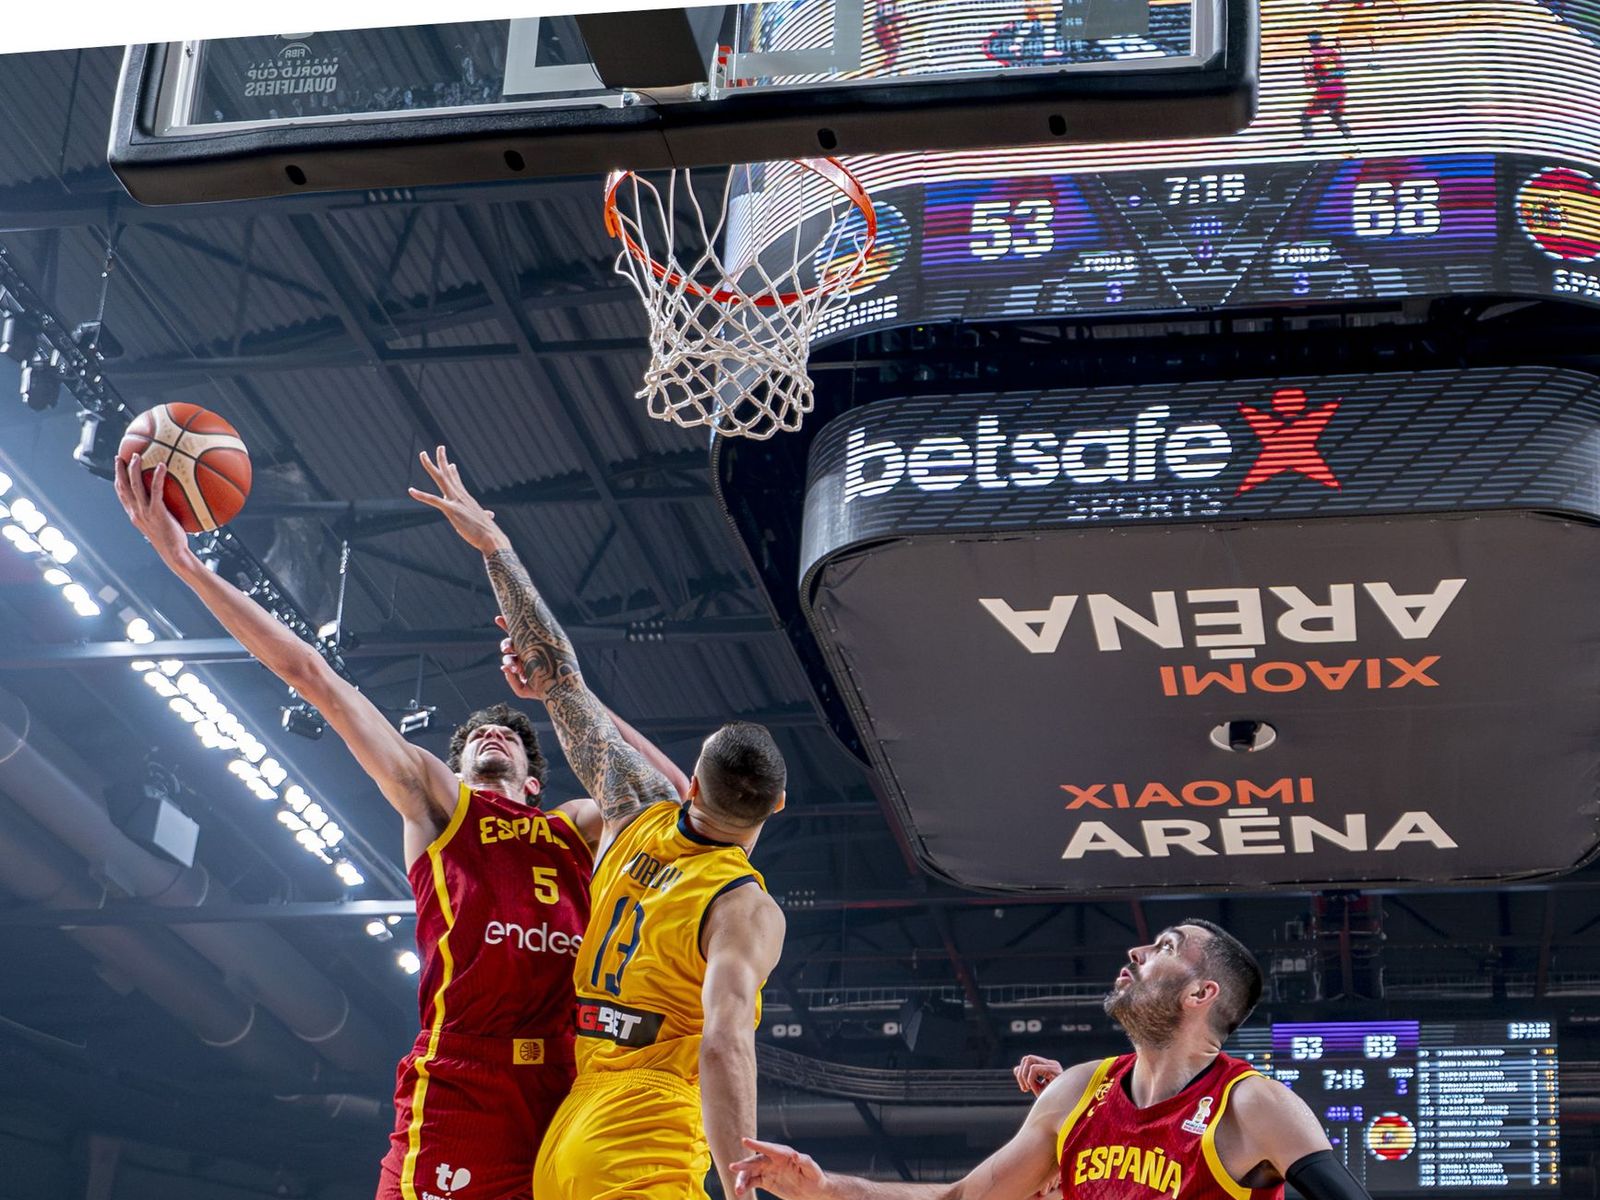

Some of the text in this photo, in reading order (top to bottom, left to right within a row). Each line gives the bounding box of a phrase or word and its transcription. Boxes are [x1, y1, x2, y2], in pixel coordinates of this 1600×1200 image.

[969, 199, 1056, 260] 53
[1353, 179, 1441, 236] 68
[808, 295, 898, 342] KRAINE
[845, 405, 1233, 503] betsafe
[978, 578, 1468, 660] ARĒNA
[1159, 655, 1442, 697] XIAOMI
[1060, 777, 1316, 810] XIAOMI
[479, 815, 570, 850] ESPA
[1061, 807, 1460, 860] ARĒNA
[532, 866, 560, 905] 5
[484, 920, 584, 958] endes
[590, 896, 646, 998] 13
[576, 1003, 643, 1040] G.BET
[1322, 1069, 1365, 1090] 7:16
[1075, 1145, 1183, 1200] ESPAÑA
